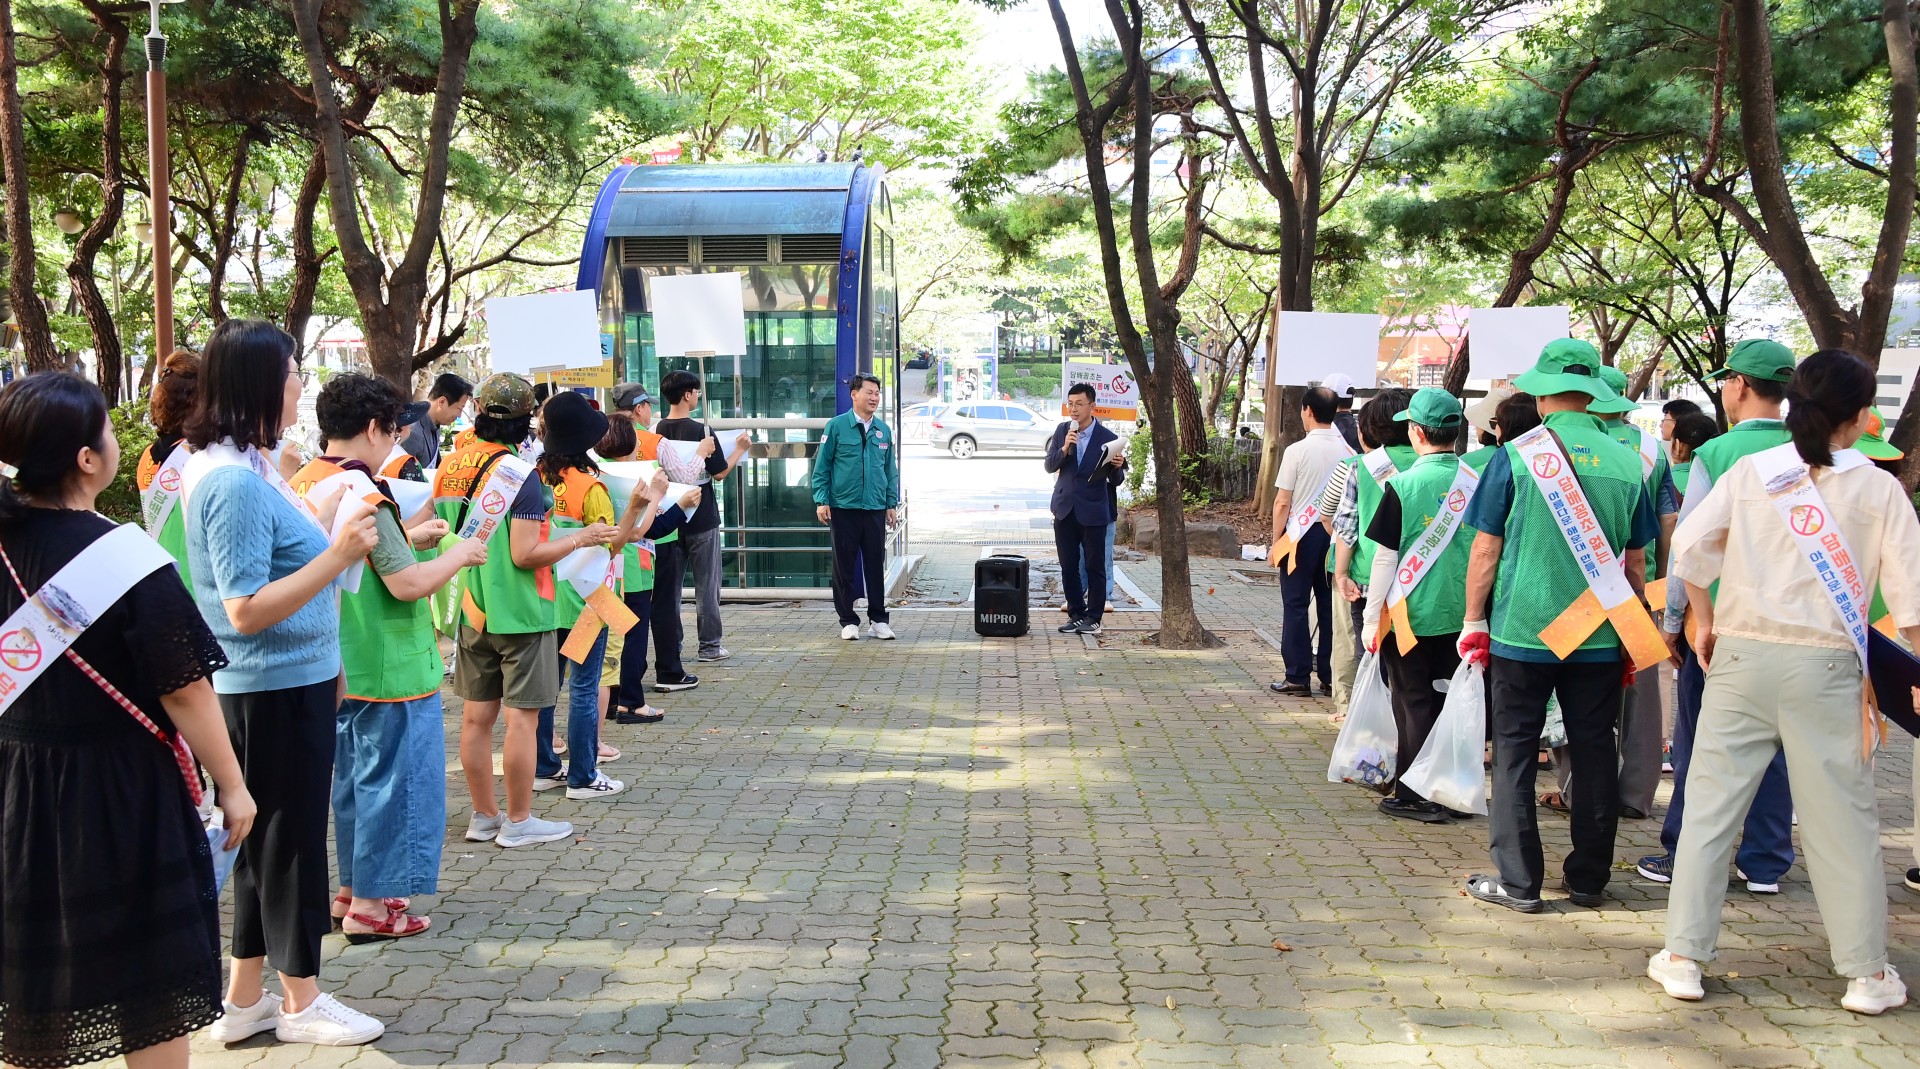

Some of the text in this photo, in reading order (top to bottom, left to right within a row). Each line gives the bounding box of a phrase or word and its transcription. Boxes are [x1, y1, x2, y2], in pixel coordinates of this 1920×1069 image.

[1070, 371, 1102, 381] 담배꽁초는
[1571, 446, 1591, 454] SMU
[1416, 511, 1455, 559] 담배꽁초
[1548, 490, 1600, 579] 아름다운 해운대 만들기
[1557, 475, 1611, 565] 담배꽁초 없는
[1398, 555, 1425, 585] NO
[1809, 549, 1842, 593] 아름다운
[1834, 591, 1859, 624] 해운대
[1820, 531, 1864, 600] 담배꽁초
[980, 614, 1017, 624] MIPRO
